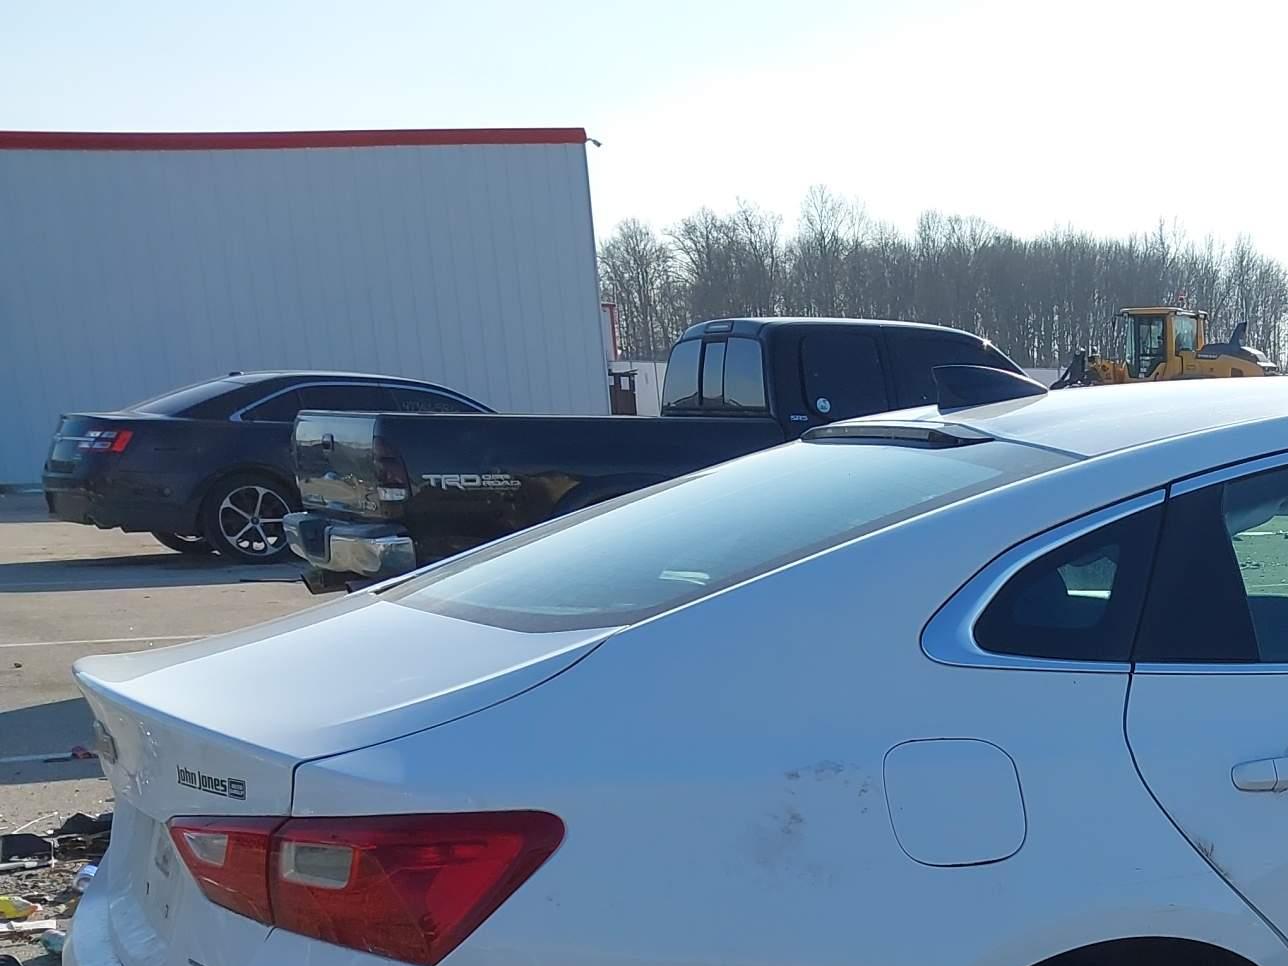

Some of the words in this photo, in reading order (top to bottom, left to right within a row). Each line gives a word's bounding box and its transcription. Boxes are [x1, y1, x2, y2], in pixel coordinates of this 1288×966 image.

[421, 474, 482, 490] TRD
[176, 764, 199, 790] John
[198, 770, 228, 797] Jones
